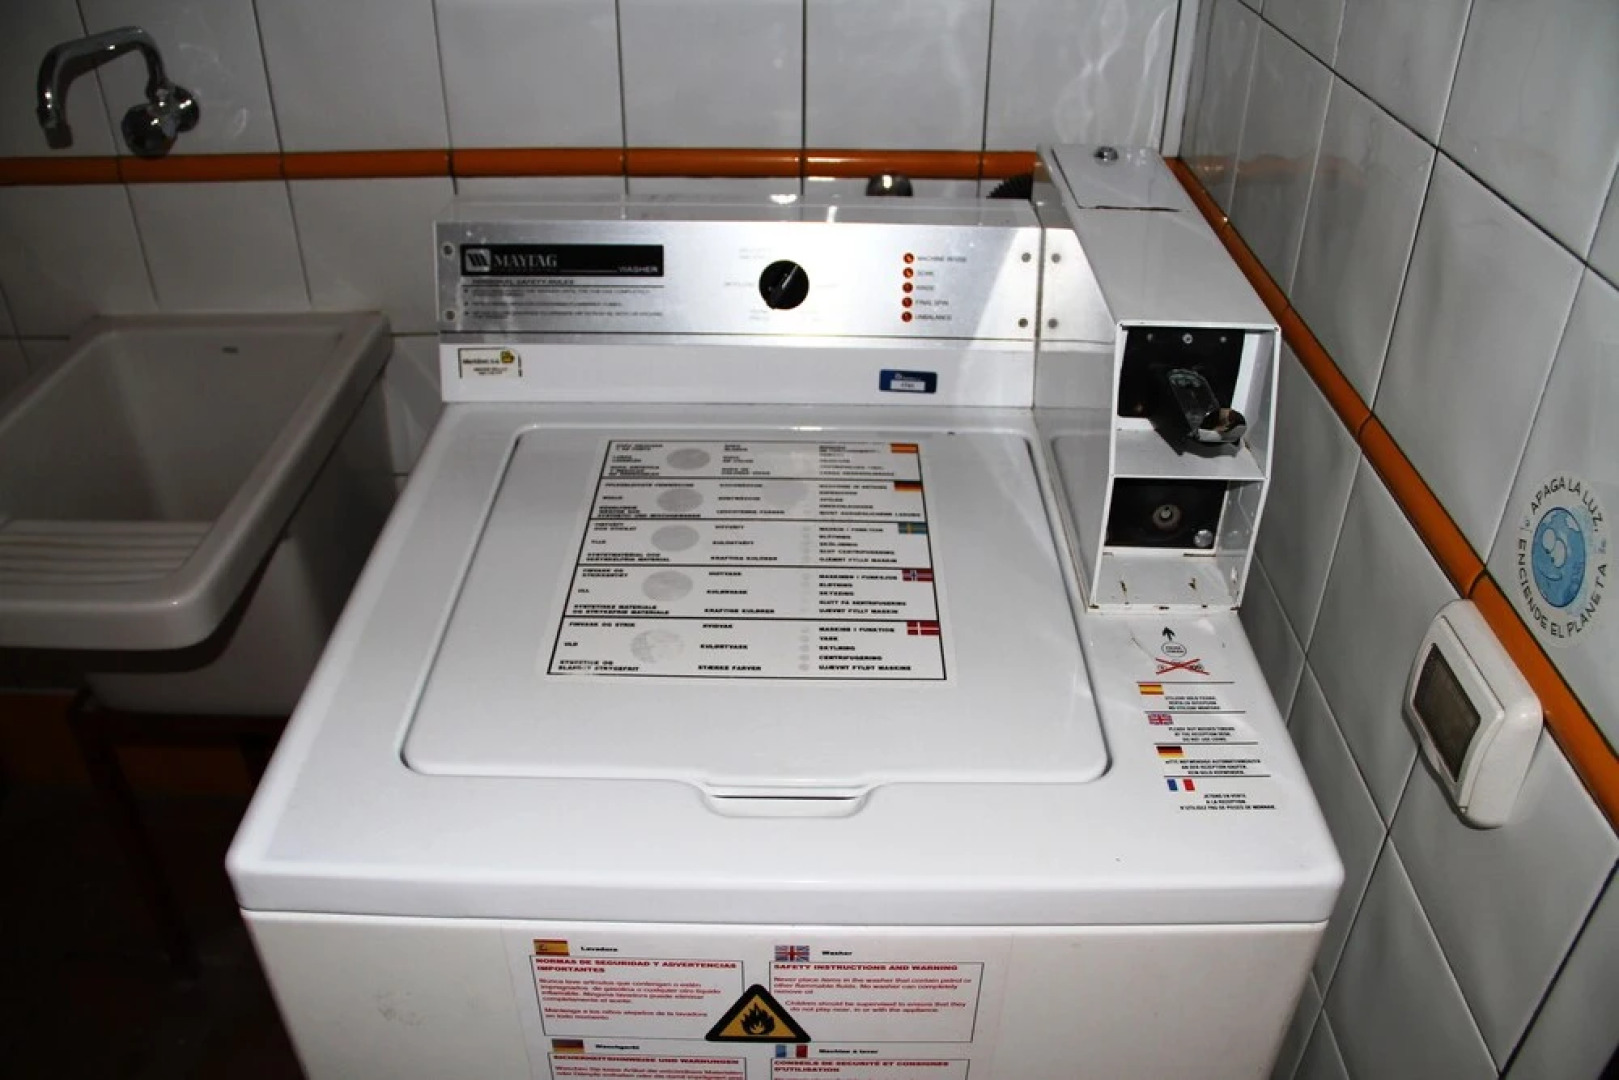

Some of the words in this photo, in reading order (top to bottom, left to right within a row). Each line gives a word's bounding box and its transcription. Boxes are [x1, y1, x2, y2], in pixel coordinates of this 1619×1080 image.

[493, 253, 558, 268] MAYTAG
[1531, 476, 1566, 515] APAGA
[1568, 478, 1581, 496] LA
[1517, 538, 1548, 630] ENCIENDE
[1550, 622, 1564, 638] EL
[1566, 563, 1607, 637] PLANETA
[535, 958, 577, 966] NORMAS
[595, 959, 650, 968] SEGURIDAD
[662, 961, 737, 970] ADVERTENCIAS
[537, 966, 606, 974] IMPORTANTES
